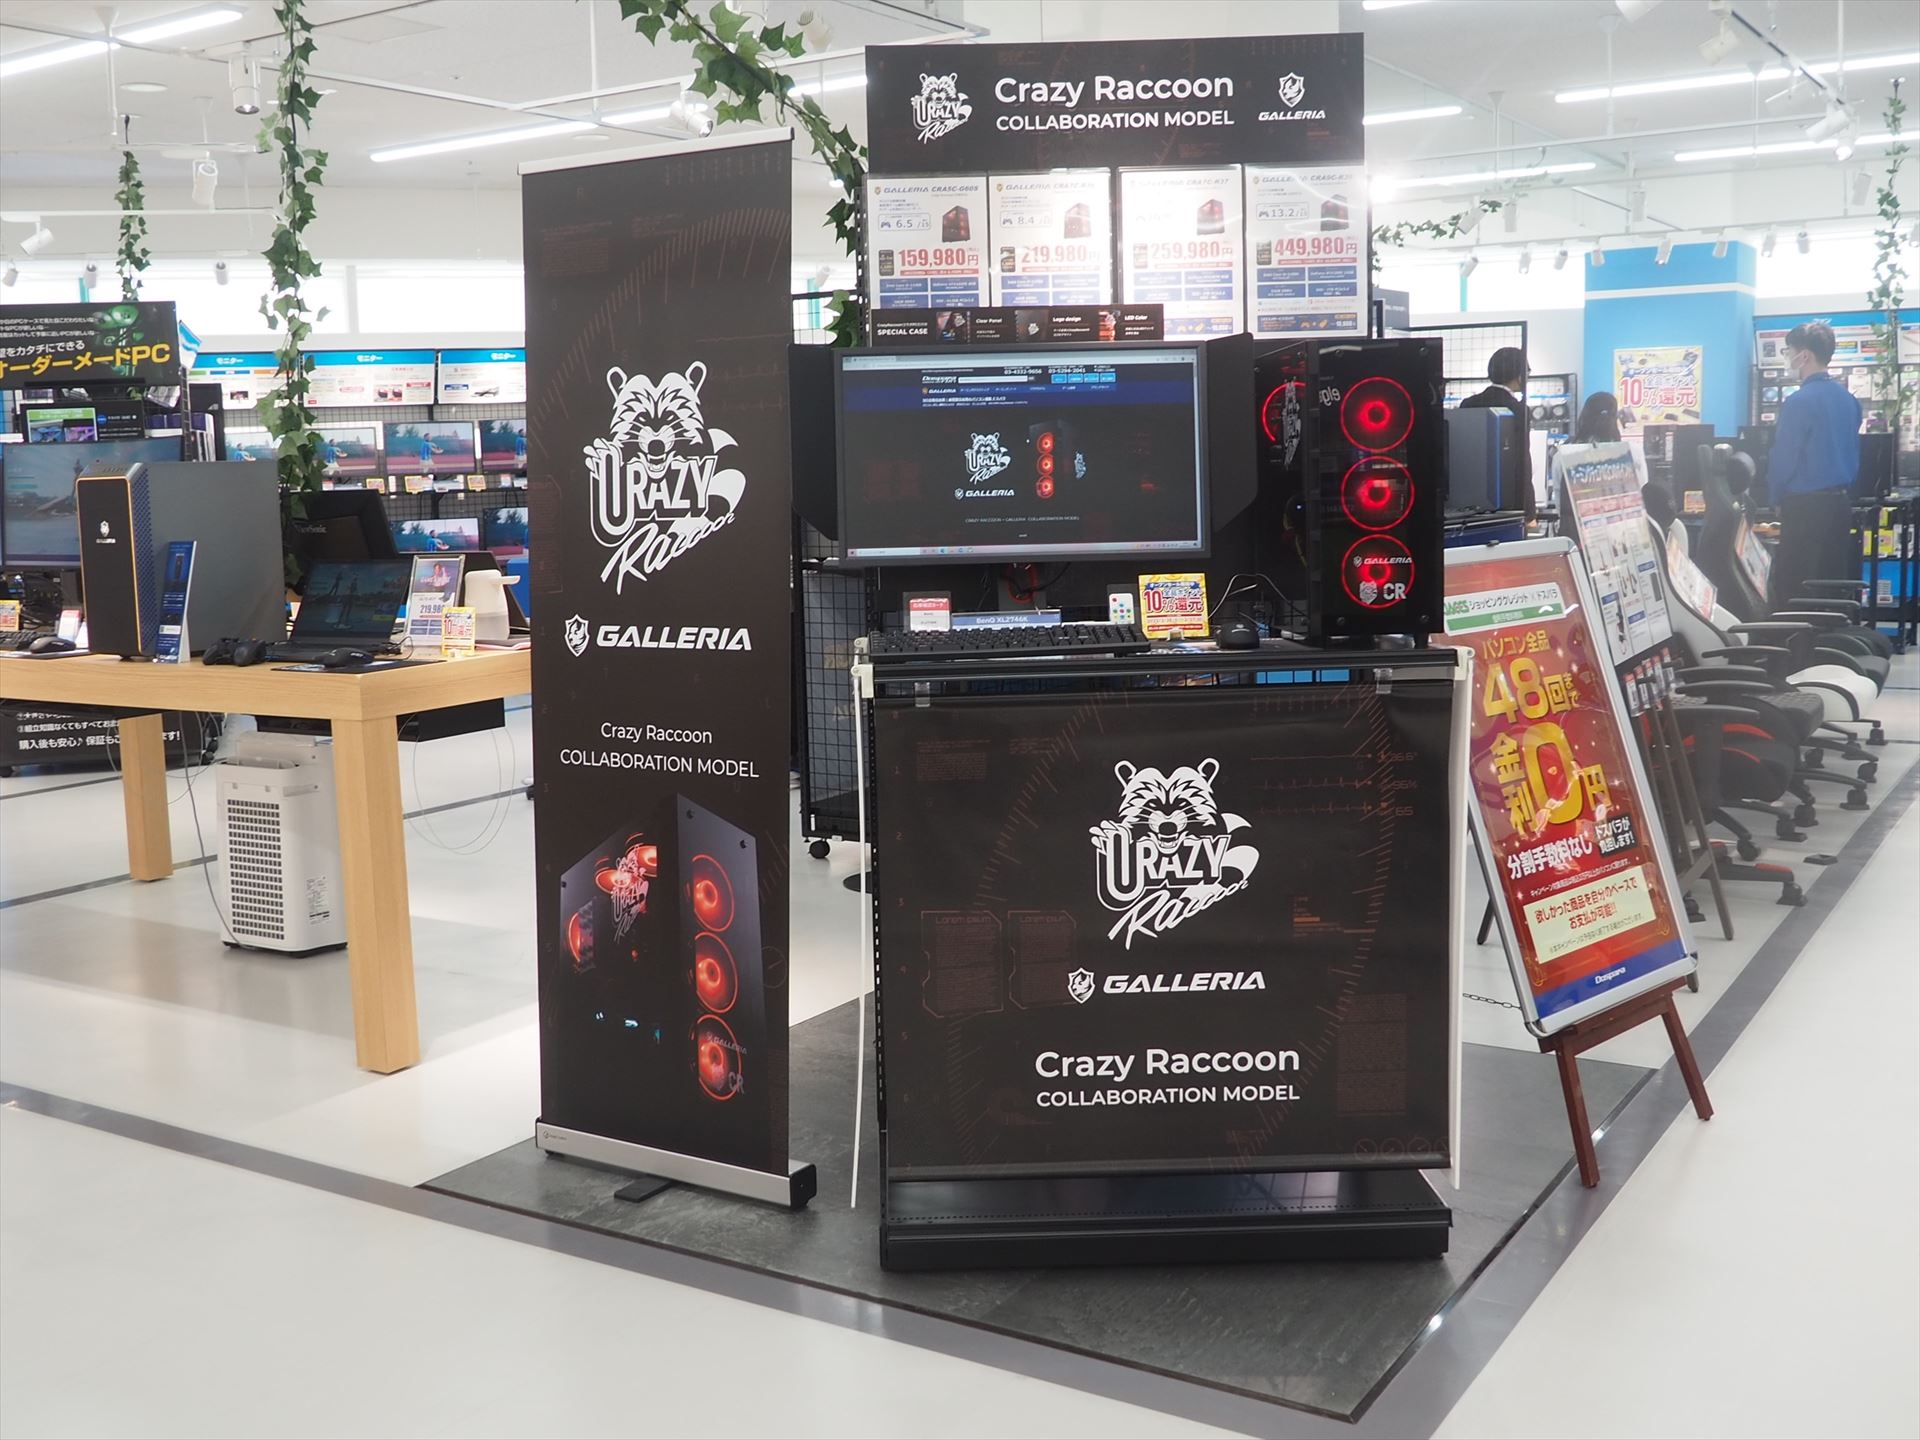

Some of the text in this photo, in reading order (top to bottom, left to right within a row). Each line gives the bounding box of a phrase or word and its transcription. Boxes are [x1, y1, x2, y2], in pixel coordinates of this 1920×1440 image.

[995, 75, 1233, 108] Crazy Raccoon
[996, 110, 1235, 131] COLLABORATION MODEL
[1258, 109, 1326, 121] GALLERIA
[896, 219, 913, 228] 6.5
[898, 247, 979, 268] 159,980円
[1273, 236, 1358, 257] 449,980円
[965, 489, 1015, 498] GALLERIA
[600, 511, 736, 595] Raccoon
[1363, 557, 1413, 565] GALLERIA
[1144, 590, 1203, 612] 10%還元
[1383, 582, 1406, 600] CR
[596, 625, 752, 651] GALLERIA
[1482, 630, 1551, 659] パソコン全品
[600, 722, 713, 744] Crazy Raccoon
[560, 749, 760, 778] COLLABORATION MODEL
[1595, 816, 1631, 840] ドスパラが
[1506, 834, 1593, 880] 分割手数料なし
[1534, 876, 1639, 924] 欲しかった商品を自分のペースで
[1107, 879, 1250, 951] Raccoon
[1103, 971, 1267, 994] GALLERIA
[1594, 966, 1627, 985] Dospara
[1035, 1048, 1300, 1083] Crazy Raccoon
[1036, 1084, 1301, 1108] COLLABORATION MODEL
